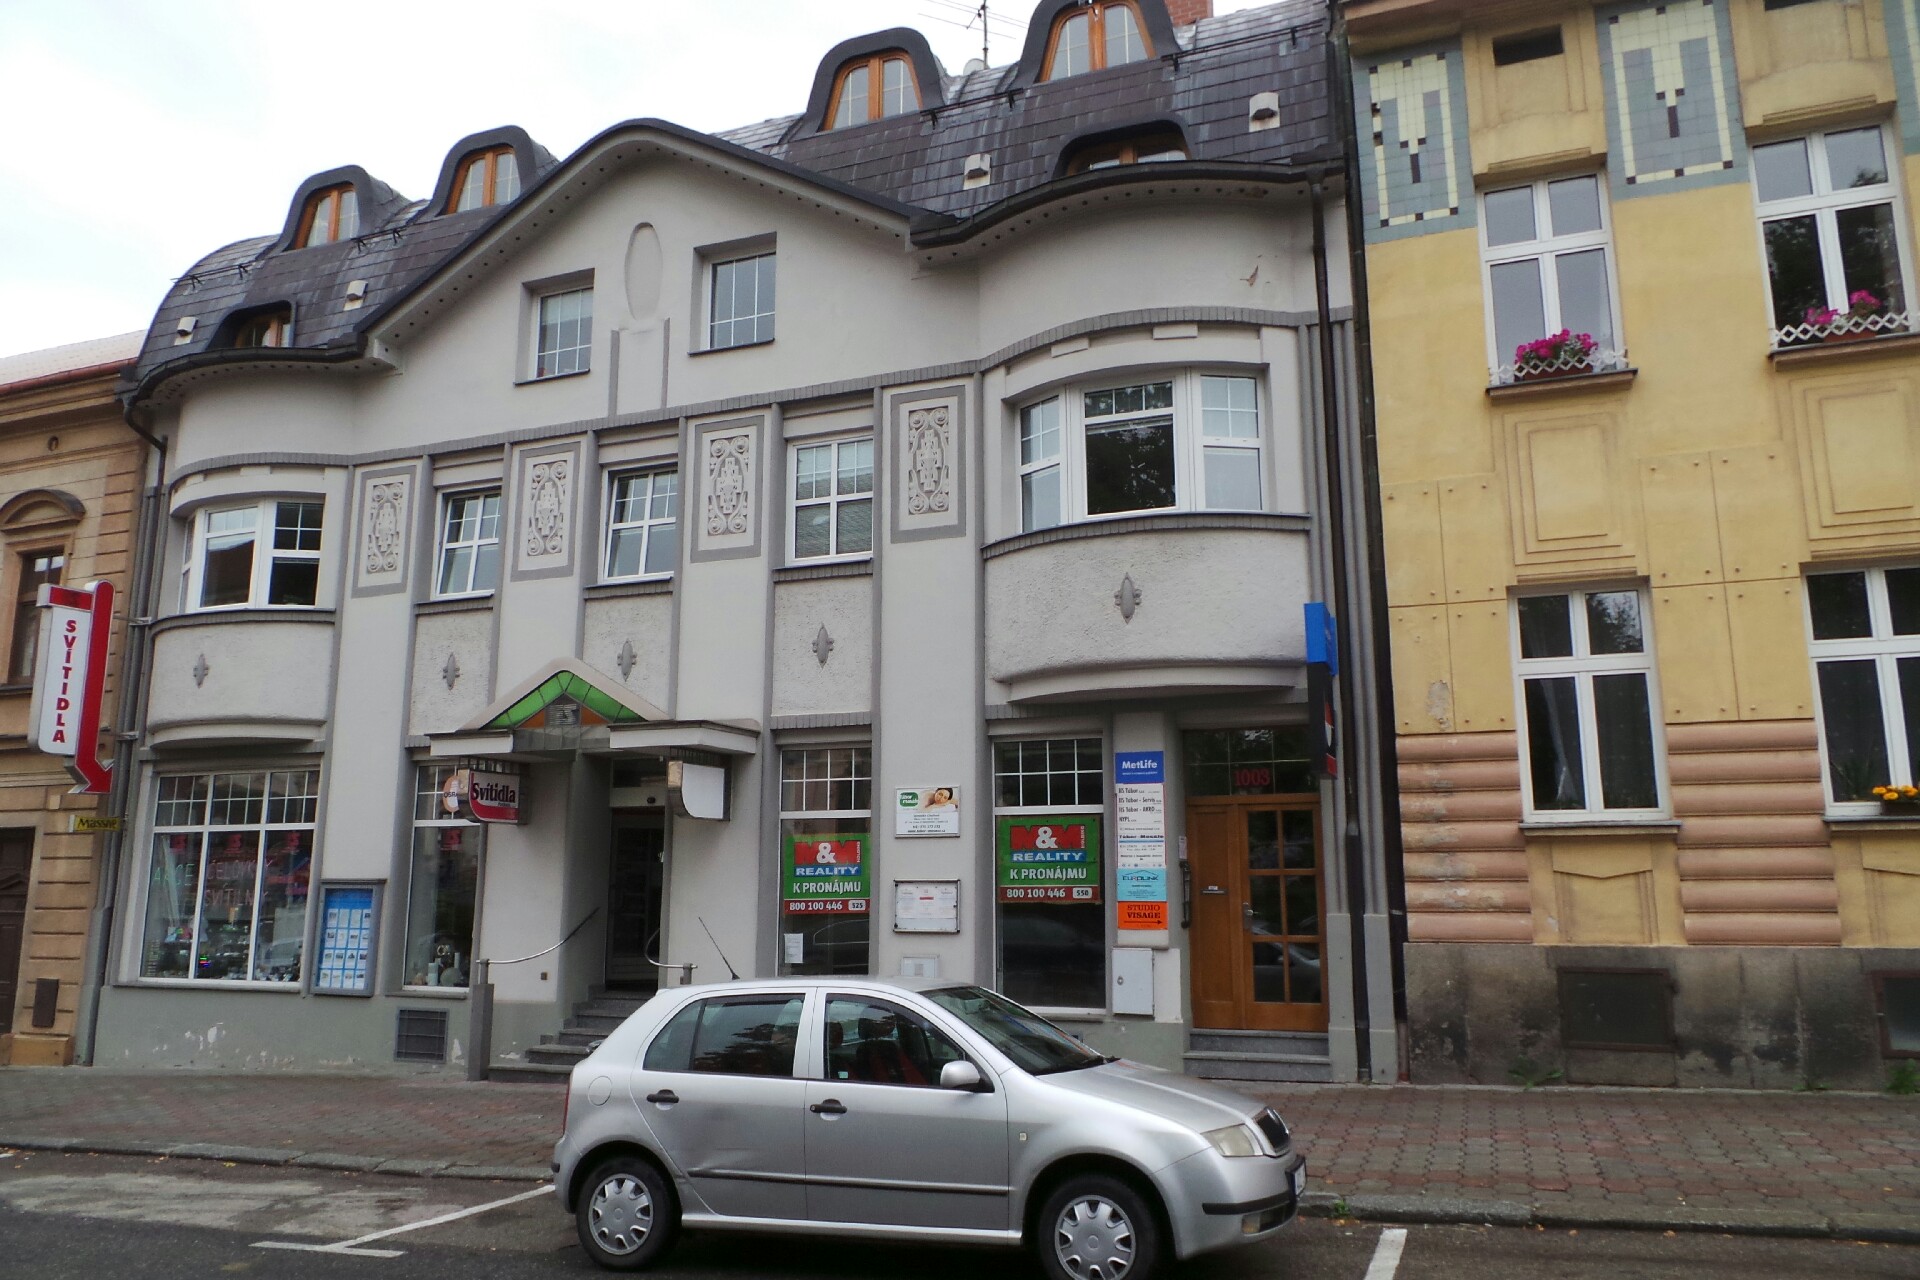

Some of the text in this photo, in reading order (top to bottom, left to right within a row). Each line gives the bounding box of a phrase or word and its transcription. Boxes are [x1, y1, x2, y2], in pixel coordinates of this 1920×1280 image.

[52, 619, 77, 744] SVÍTIDLA
[1122, 760, 1158, 769] MetLife
[1233, 768, 1270, 787] 1003
[471, 782, 516, 803] Svítidla
[1010, 824, 1081, 849] M&M
[795, 840, 857, 865] M&M
[1012, 852, 1083, 861] REALITY
[796, 866, 859, 876] REALITY
[1010, 865, 1087, 881] K PRONÁJMU
[793, 879, 861, 895] K PRONÁJMU
[1006, 888, 1024, 898] 800
[1027, 888, 1045, 898] 100
[1047, 888, 1066, 898] 446
[789, 902, 806, 911] 800
[808, 901, 824, 910] 100
[826, 901, 843, 910] 446
[1127, 911, 1161, 919] VISAGE
